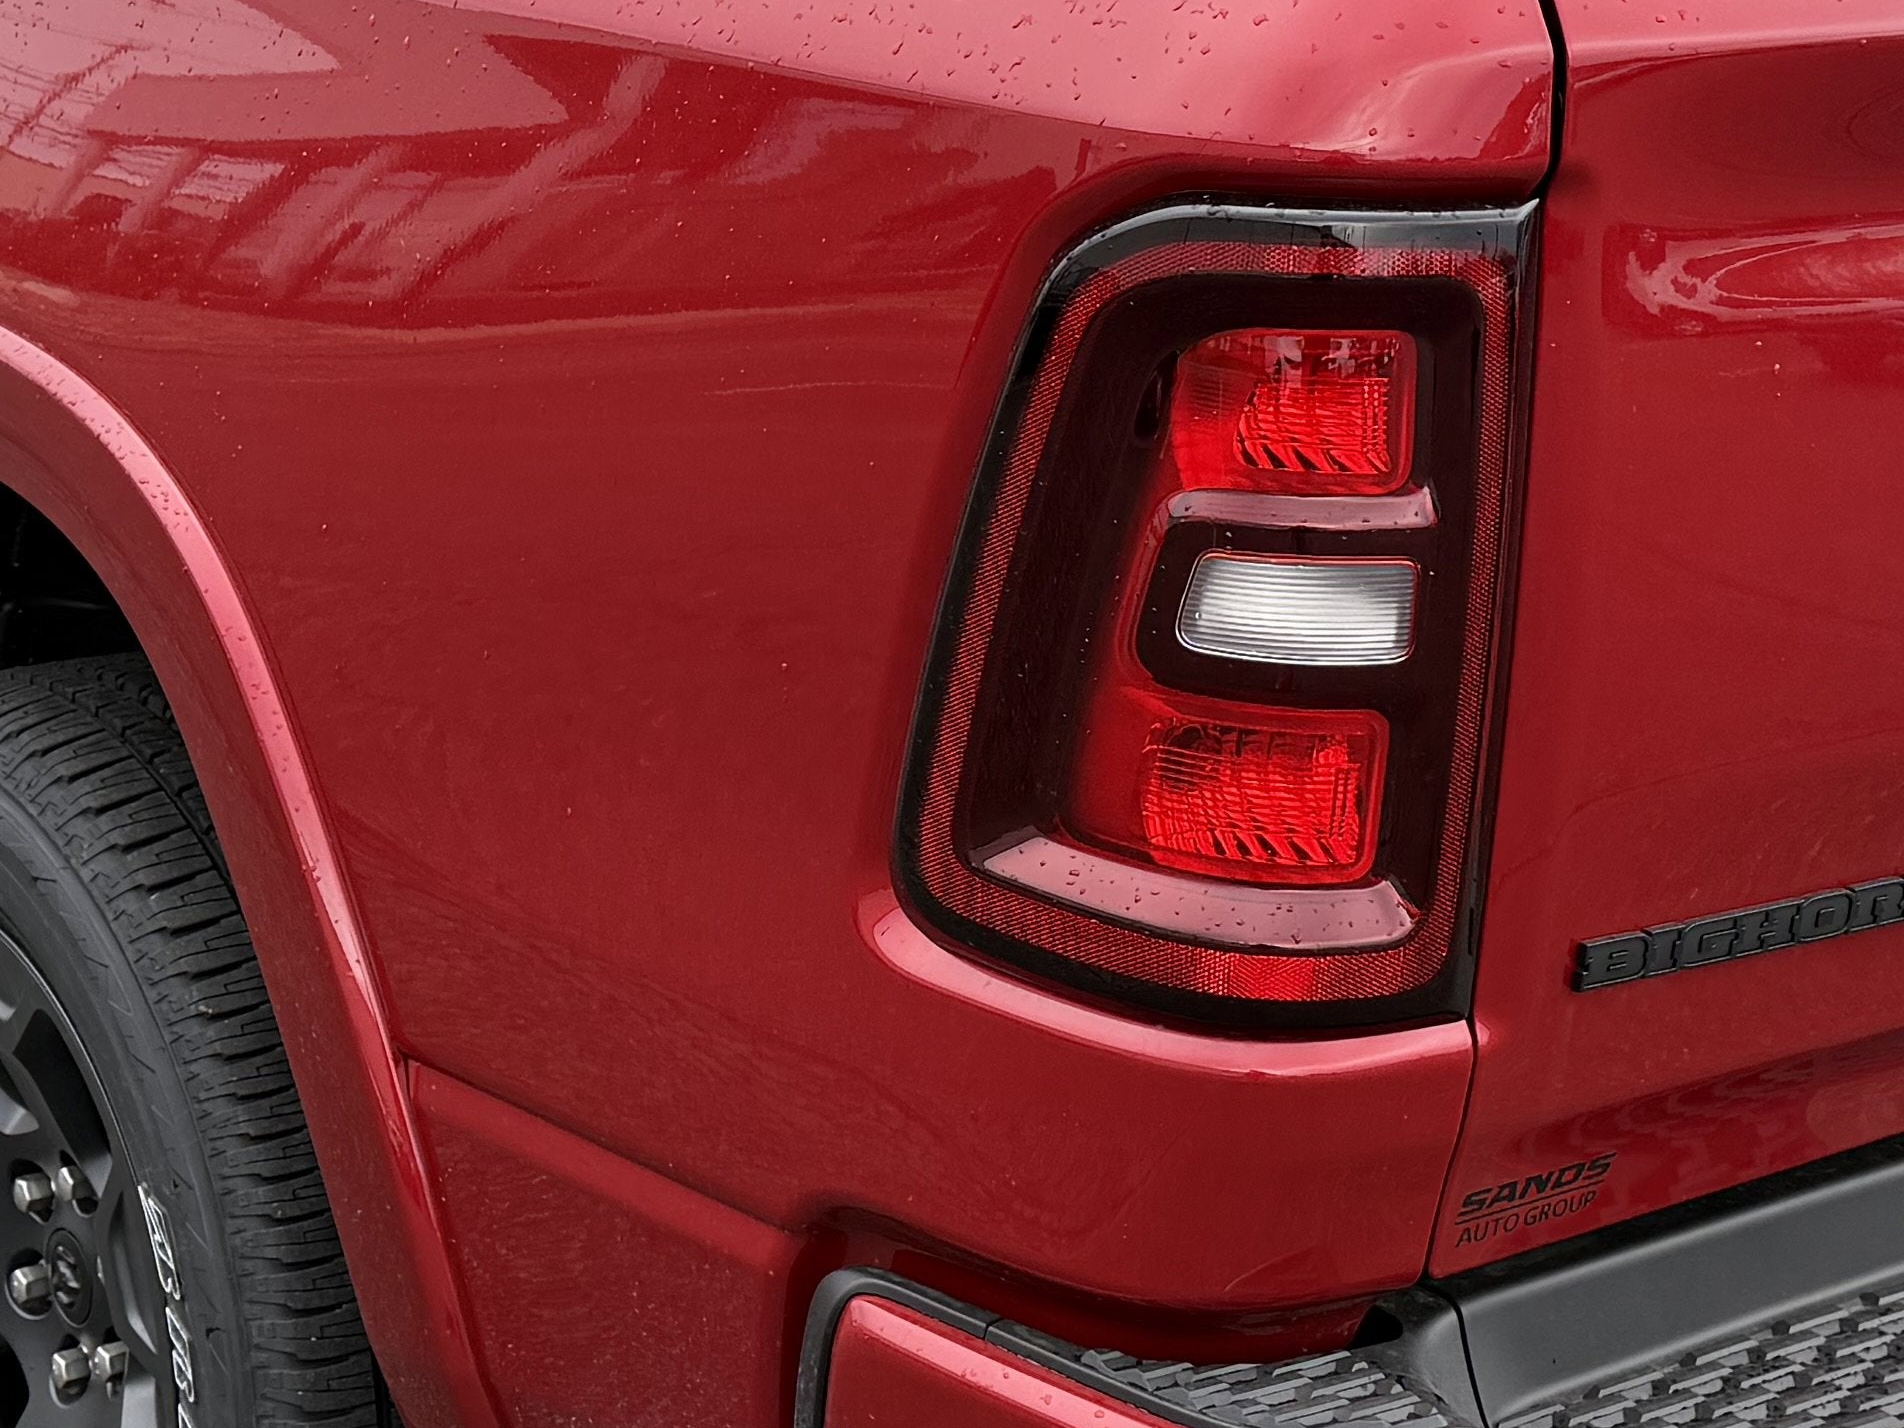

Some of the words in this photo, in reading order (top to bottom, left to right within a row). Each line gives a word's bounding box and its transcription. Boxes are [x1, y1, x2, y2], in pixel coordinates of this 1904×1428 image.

[1456, 1151, 1618, 1218] SANDS
[1454, 1212, 1520, 1249] AUTO
[1523, 1189, 1598, 1227] GROUP
